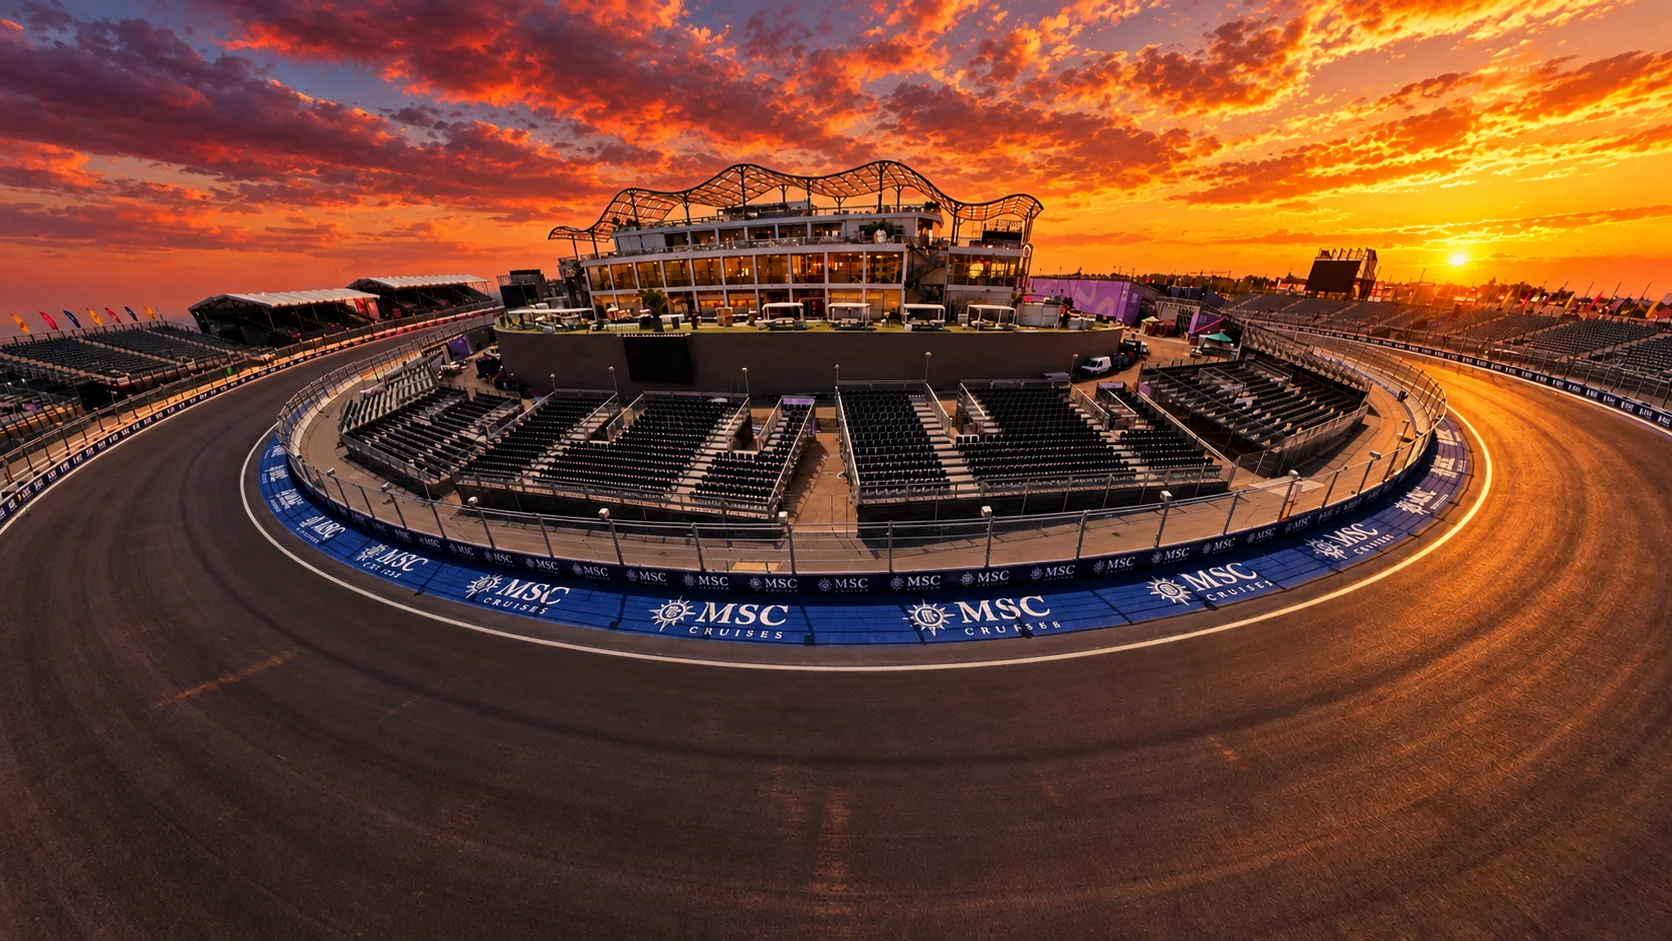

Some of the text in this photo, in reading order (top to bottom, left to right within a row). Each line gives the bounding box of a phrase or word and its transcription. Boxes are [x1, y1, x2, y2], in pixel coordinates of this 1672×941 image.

[1256, 527, 1276, 540] MSC
[1213, 538, 1236, 551] MSC
[494, 552, 513, 564] MSC
[1165, 547, 1190, 561] MSC
[536, 559, 558, 571] MSC
[1107, 556, 1136, 570] MSC
[583, 565, 609, 577] MSC
[639, 571, 667, 582] MSC
[977, 571, 1010, 583] MSC
[1045, 565, 1076, 577] MSC
[1178, 562, 1257, 591] MSC
[699, 576, 729, 587] MSC
[765, 578, 798, 589] MSC
[835, 578, 868, 589] MSC
[907, 575, 941, 587] MSC
[495, 579, 571, 605] MSC
[695, 601, 789, 626] MSC
[954, 595, 1051, 624] MSC
[689, 626, 783, 639] CRUISES
